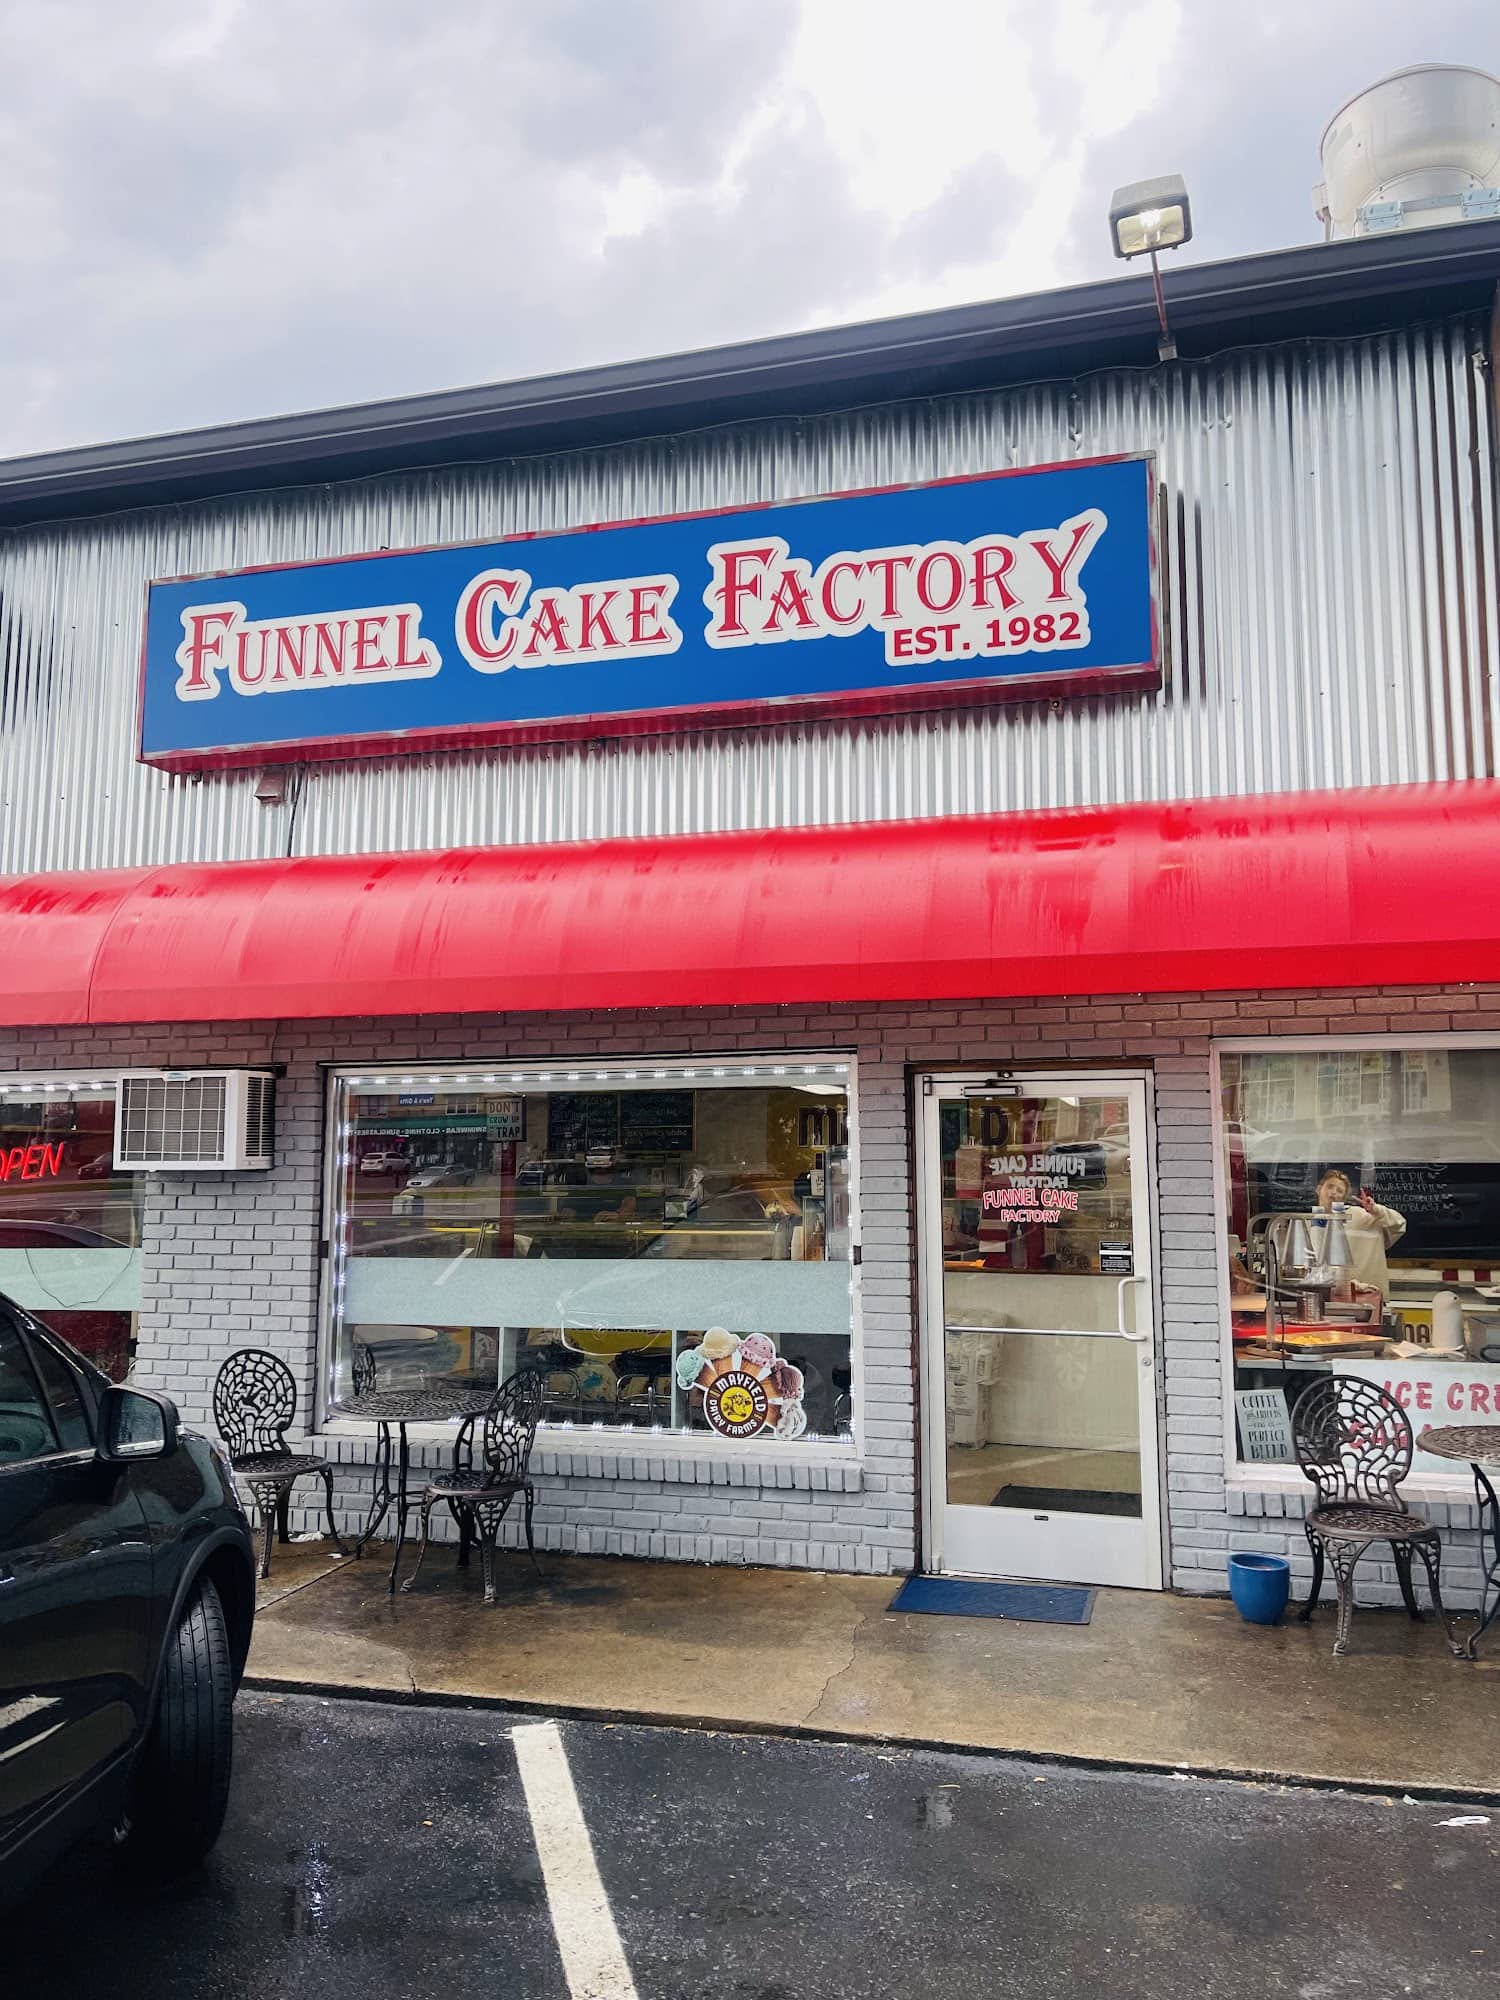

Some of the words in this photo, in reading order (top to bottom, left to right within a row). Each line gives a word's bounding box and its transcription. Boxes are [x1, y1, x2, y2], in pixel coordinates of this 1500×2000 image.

[182, 609, 433, 693] FUNNEL
[463, 577, 671, 662] CAKE
[714, 519, 1096, 638] FACTORY
[893, 623, 971, 658] EST.
[985, 611, 1081, 648] 1982
[983, 1188, 1039, 1210] FUNNEL
[1041, 1188, 1078, 1211] CAKE
[1001, 1209, 1060, 1223] FACTORY
[715, 1373, 767, 1412] MAYFIELD
[709, 1399, 726, 1427] DAIRY
[726, 1419, 758, 1435] FARMS
